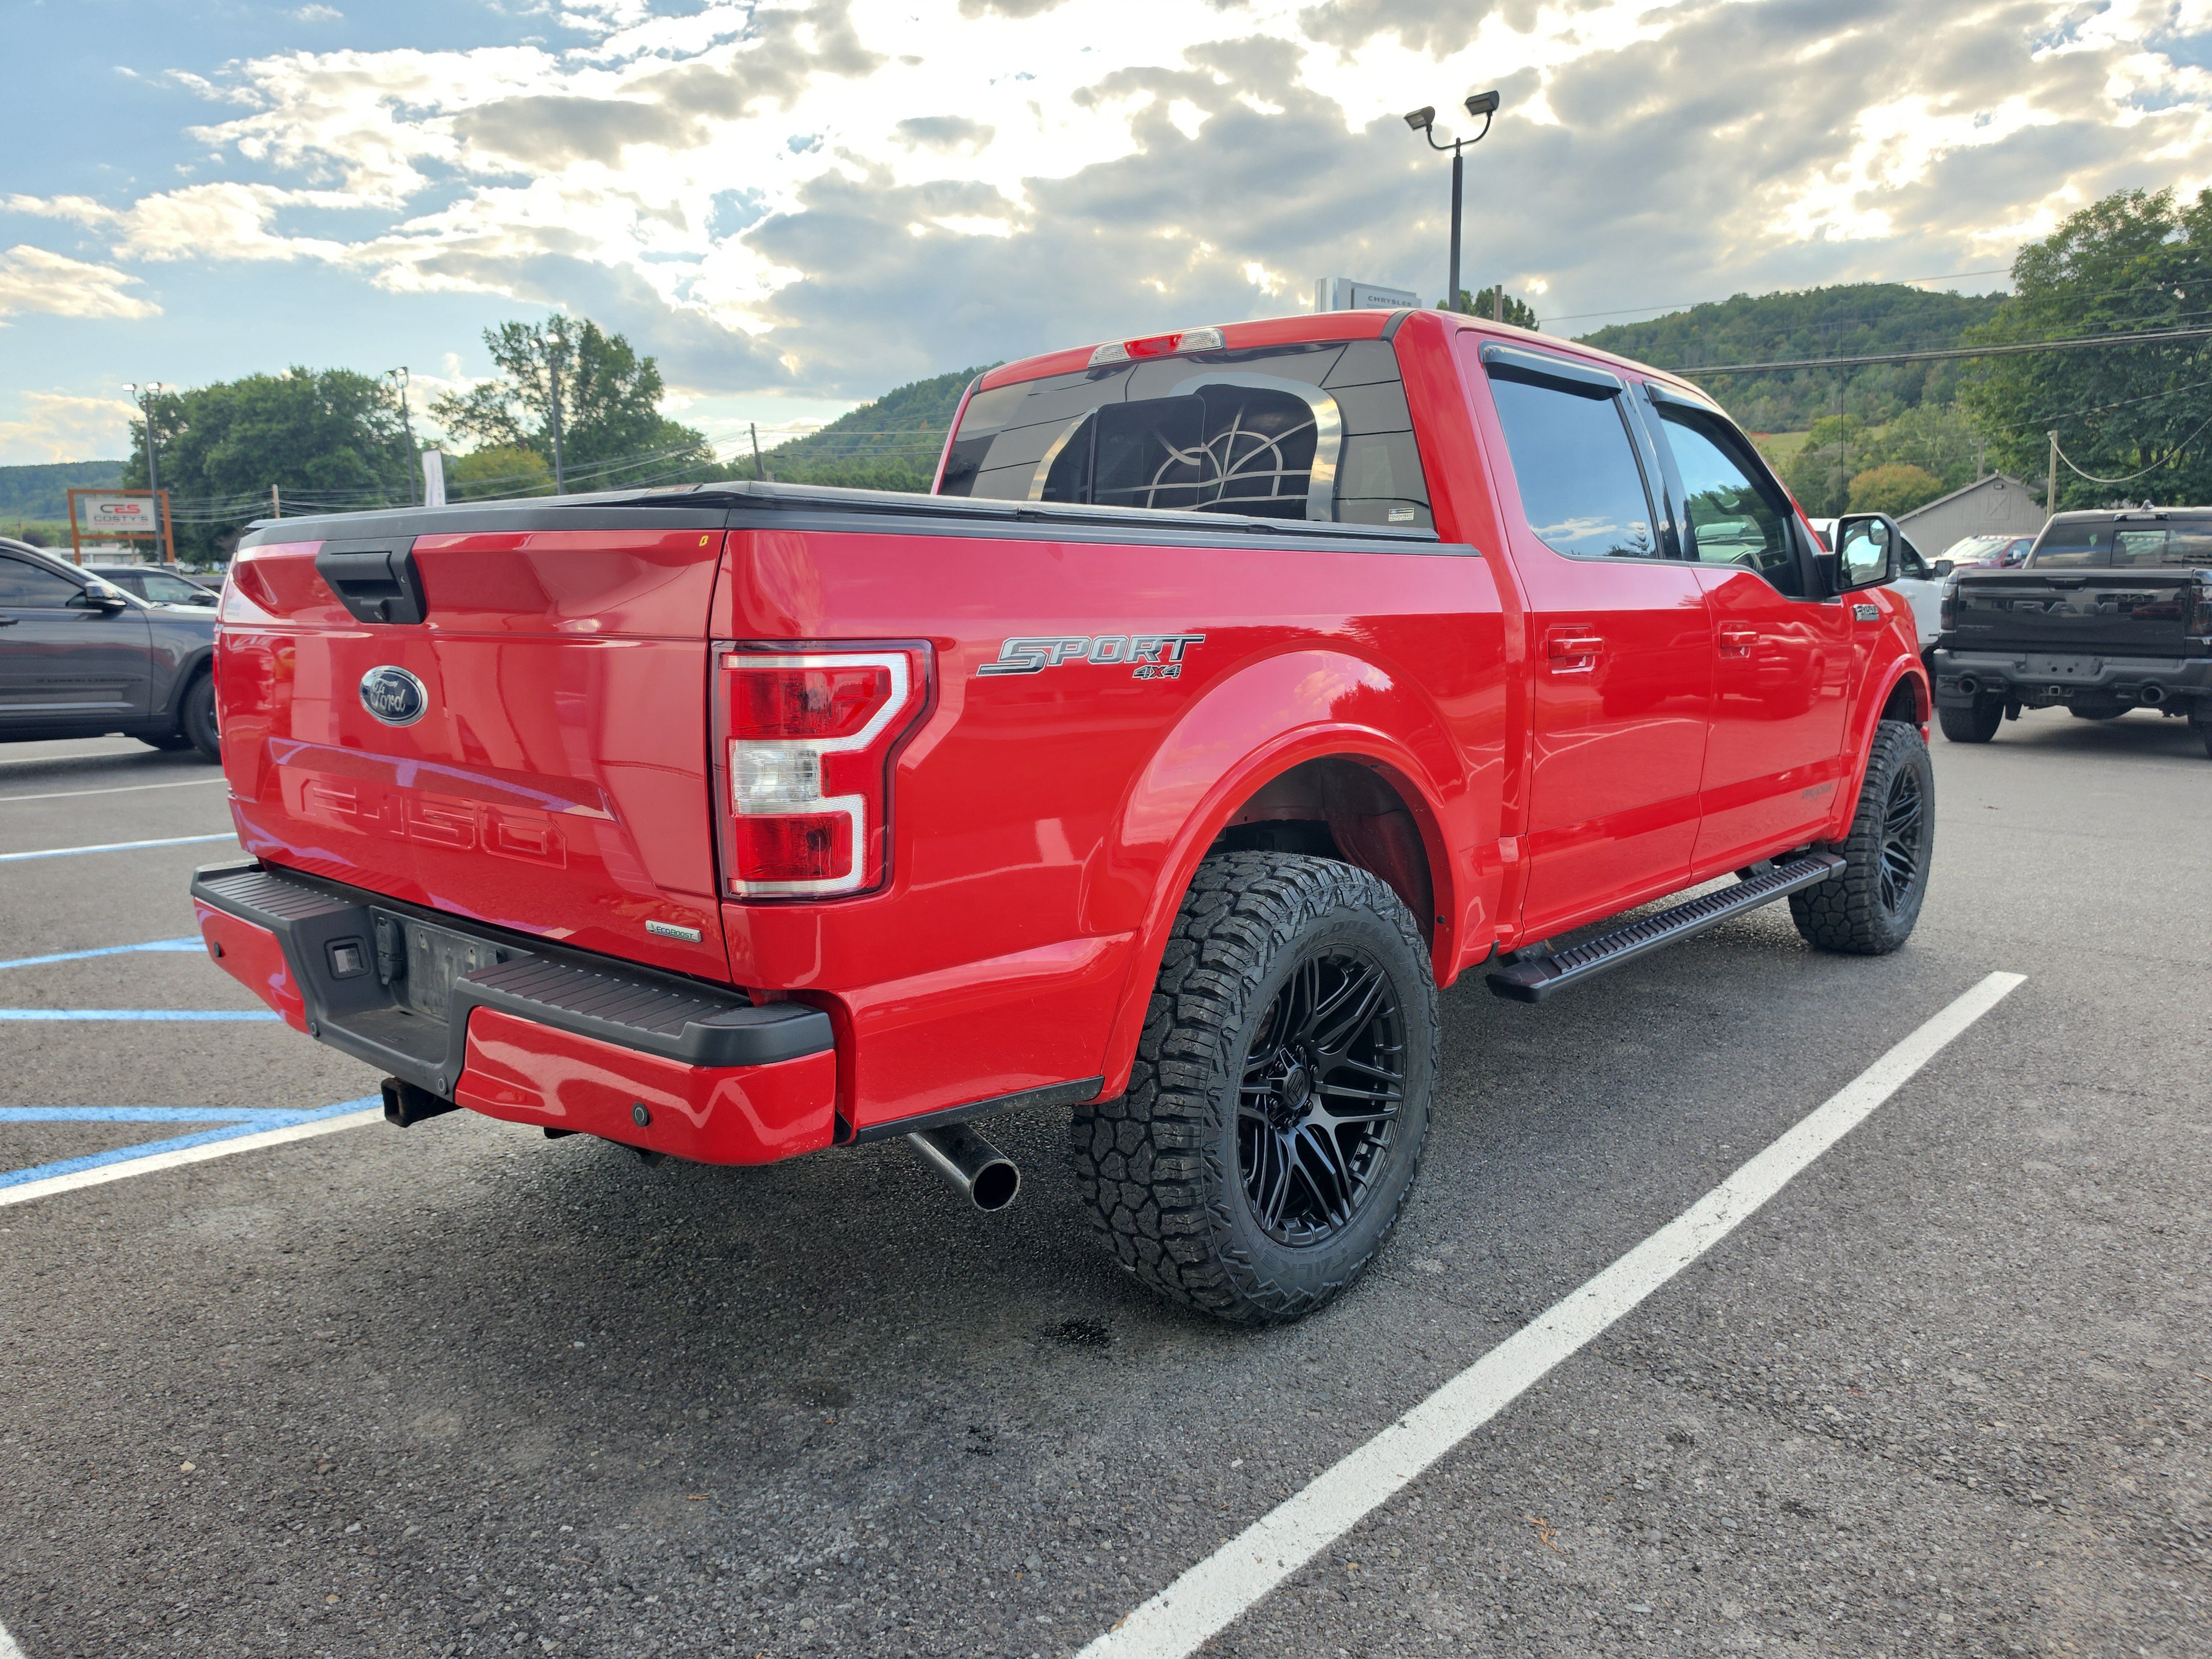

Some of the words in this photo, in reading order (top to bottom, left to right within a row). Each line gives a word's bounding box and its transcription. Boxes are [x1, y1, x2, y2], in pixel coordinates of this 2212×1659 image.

[1367, 295, 1412, 307] CHRYSLER
[100, 504, 141, 515] CES
[2012, 601, 2119, 614] RAM
[976, 633, 1207, 677] SPORT
[370, 677, 406, 713] Ford
